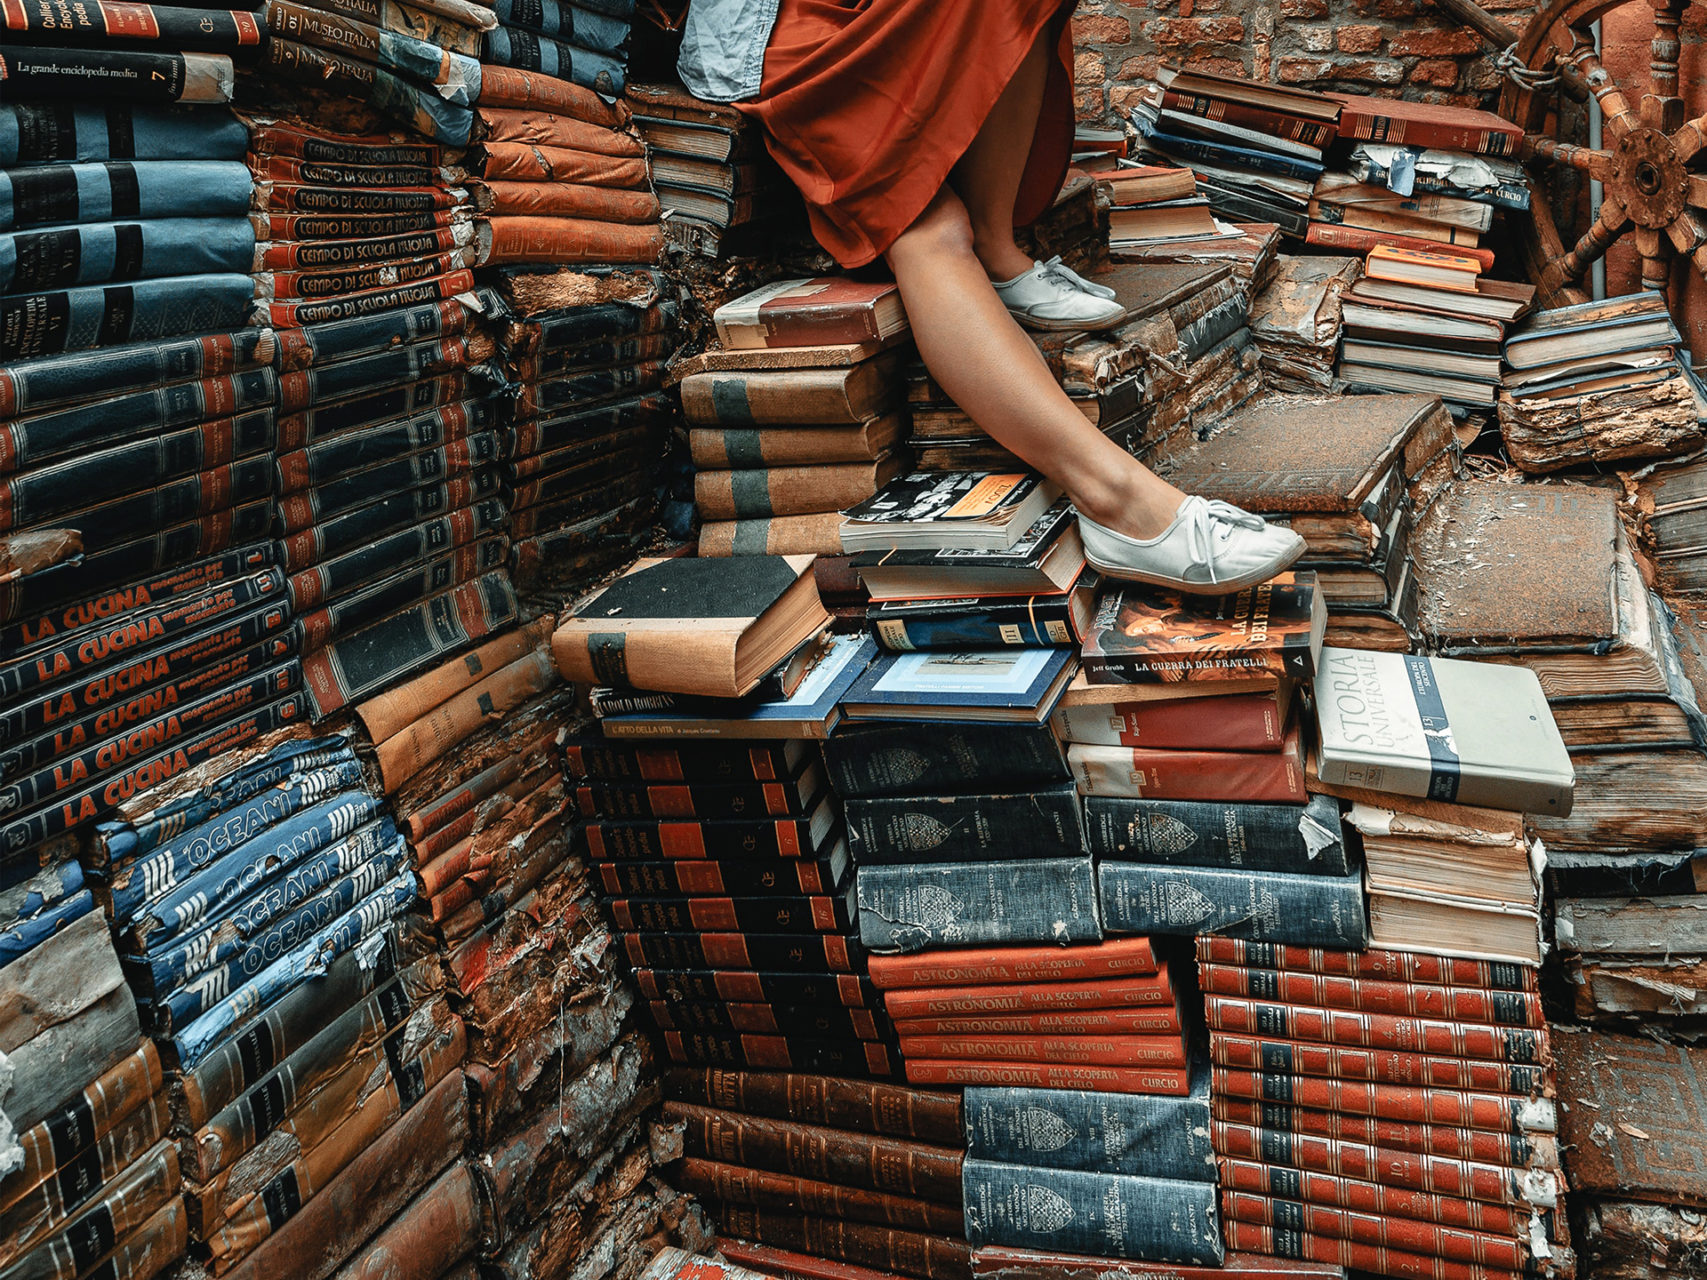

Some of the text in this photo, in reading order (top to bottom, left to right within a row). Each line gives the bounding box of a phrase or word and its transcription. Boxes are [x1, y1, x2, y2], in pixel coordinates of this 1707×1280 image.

[72, 1, 92, 28] pedia
[287, 14, 299, 30] 10
[304, 17, 377, 50] MUSEO ITALIA
[17, 61, 138, 79] La grande enciclopedia medica
[150, 70, 167, 82] 7
[341, 62, 374, 84] ITALIA
[299, 191, 339, 208] TEMPO
[341, 195, 352, 209] DI
[1495, 186, 1522, 202] CURCIO
[301, 247, 341, 264] TEMPO
[343, 245, 355, 260] DI
[357, 241, 396, 260] SCUOLA
[300, 303, 342, 322] TEMPO
[344, 300, 356, 315] DI
[359, 291, 399, 313] SCUOLA
[21, 584, 152, 645] LA CUCINA
[162, 588, 235, 624] momento per
[1004, 629, 1019, 642] III
[1250, 620, 1269, 643] DEI
[36, 615, 166, 682] LA CUCINA
[272, 639, 288, 656] 4
[1092, 664, 1125, 673] Jeff Grubb
[1135, 657, 1269, 673] LA GUERRA DEI FRATELLI
[43, 654, 171, 724] LA CUCINA
[633, 693, 676, 712] ROBBINS
[1329, 655, 1374, 745] STORIA
[1357, 656, 1396, 748] UNIVERSALE
[280, 702, 296, 719] 5
[53, 684, 179, 756] LA CUCINA
[1422, 716, 1435, 727] 13
[610, 724, 634, 735] L'ATTO
[635, 724, 657, 735] DELLA
[658, 724, 674, 735] VITA
[53, 715, 182, 791] LA CUCINA
[1131, 773, 1143, 784] 19
[1349, 769, 1364, 782] 13
[62, 748, 190, 828] LA CUCINA
[187, 791, 292, 867] OCEANI
[861, 818, 872, 853] CAMBRIDGE
[219, 825, 321, 904] OCANI
[243, 889, 344, 975] OCEANI
[1107, 957, 1145, 970] CURCIO
[912, 965, 1010, 984] ASTRONOMIA
[927, 996, 1024, 1014] ASTRONOMIA
[1030, 989, 1102, 1003] ALLA SCOPERTA
[1124, 991, 1163, 1002] CURCIO
[936, 1019, 1034, 1033] ASTRONOMIA
[1132, 1018, 1171, 1030] CURCIO
[940, 1040, 1039, 1058] ASTRONOMIA
[1136, 1048, 1175, 1061] CURCIO
[946, 1068, 1044, 1085] ASTRONOMIA
[1047, 1067, 1119, 1081] ALLA SCOPERTA
[1140, 1076, 1179, 1090] CURCIO
[979, 1182, 989, 1228] CAMBRIDGE
[1187, 1204, 1199, 1246] GARZANTI
